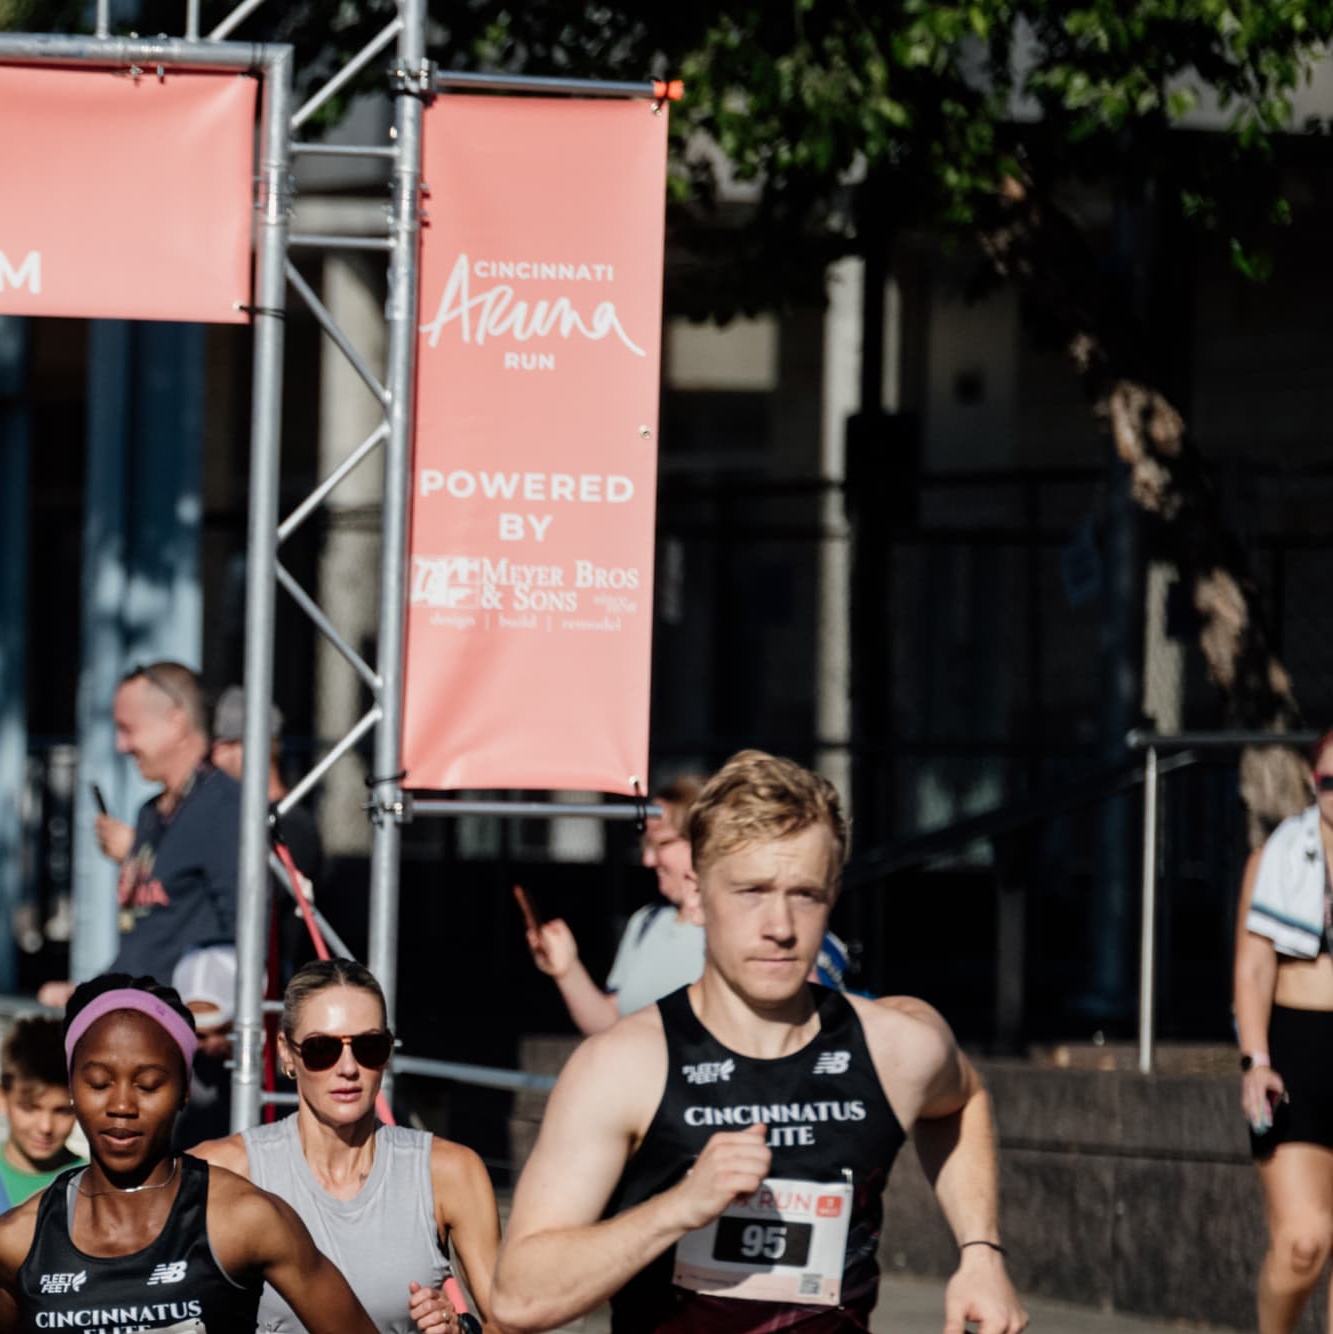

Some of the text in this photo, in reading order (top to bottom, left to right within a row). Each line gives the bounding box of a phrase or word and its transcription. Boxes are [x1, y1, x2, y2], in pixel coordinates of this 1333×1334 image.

[474, 259, 615, 282] CINCINNATI
[504, 351, 556, 372] RUN
[419, 469, 636, 502] POWERED
[498, 513, 554, 542] BY
[480, 583, 504, 611] &
[684, 1101, 867, 1126] CINCINNATUS
[757, 1191, 813, 1212] RUN
[740, 1225, 788, 1259] 95
[39, 1273, 73, 1285] FLEET
[41, 1283, 71, 1294] FEET
[35, 1300, 202, 1328] CINCINNATUS
